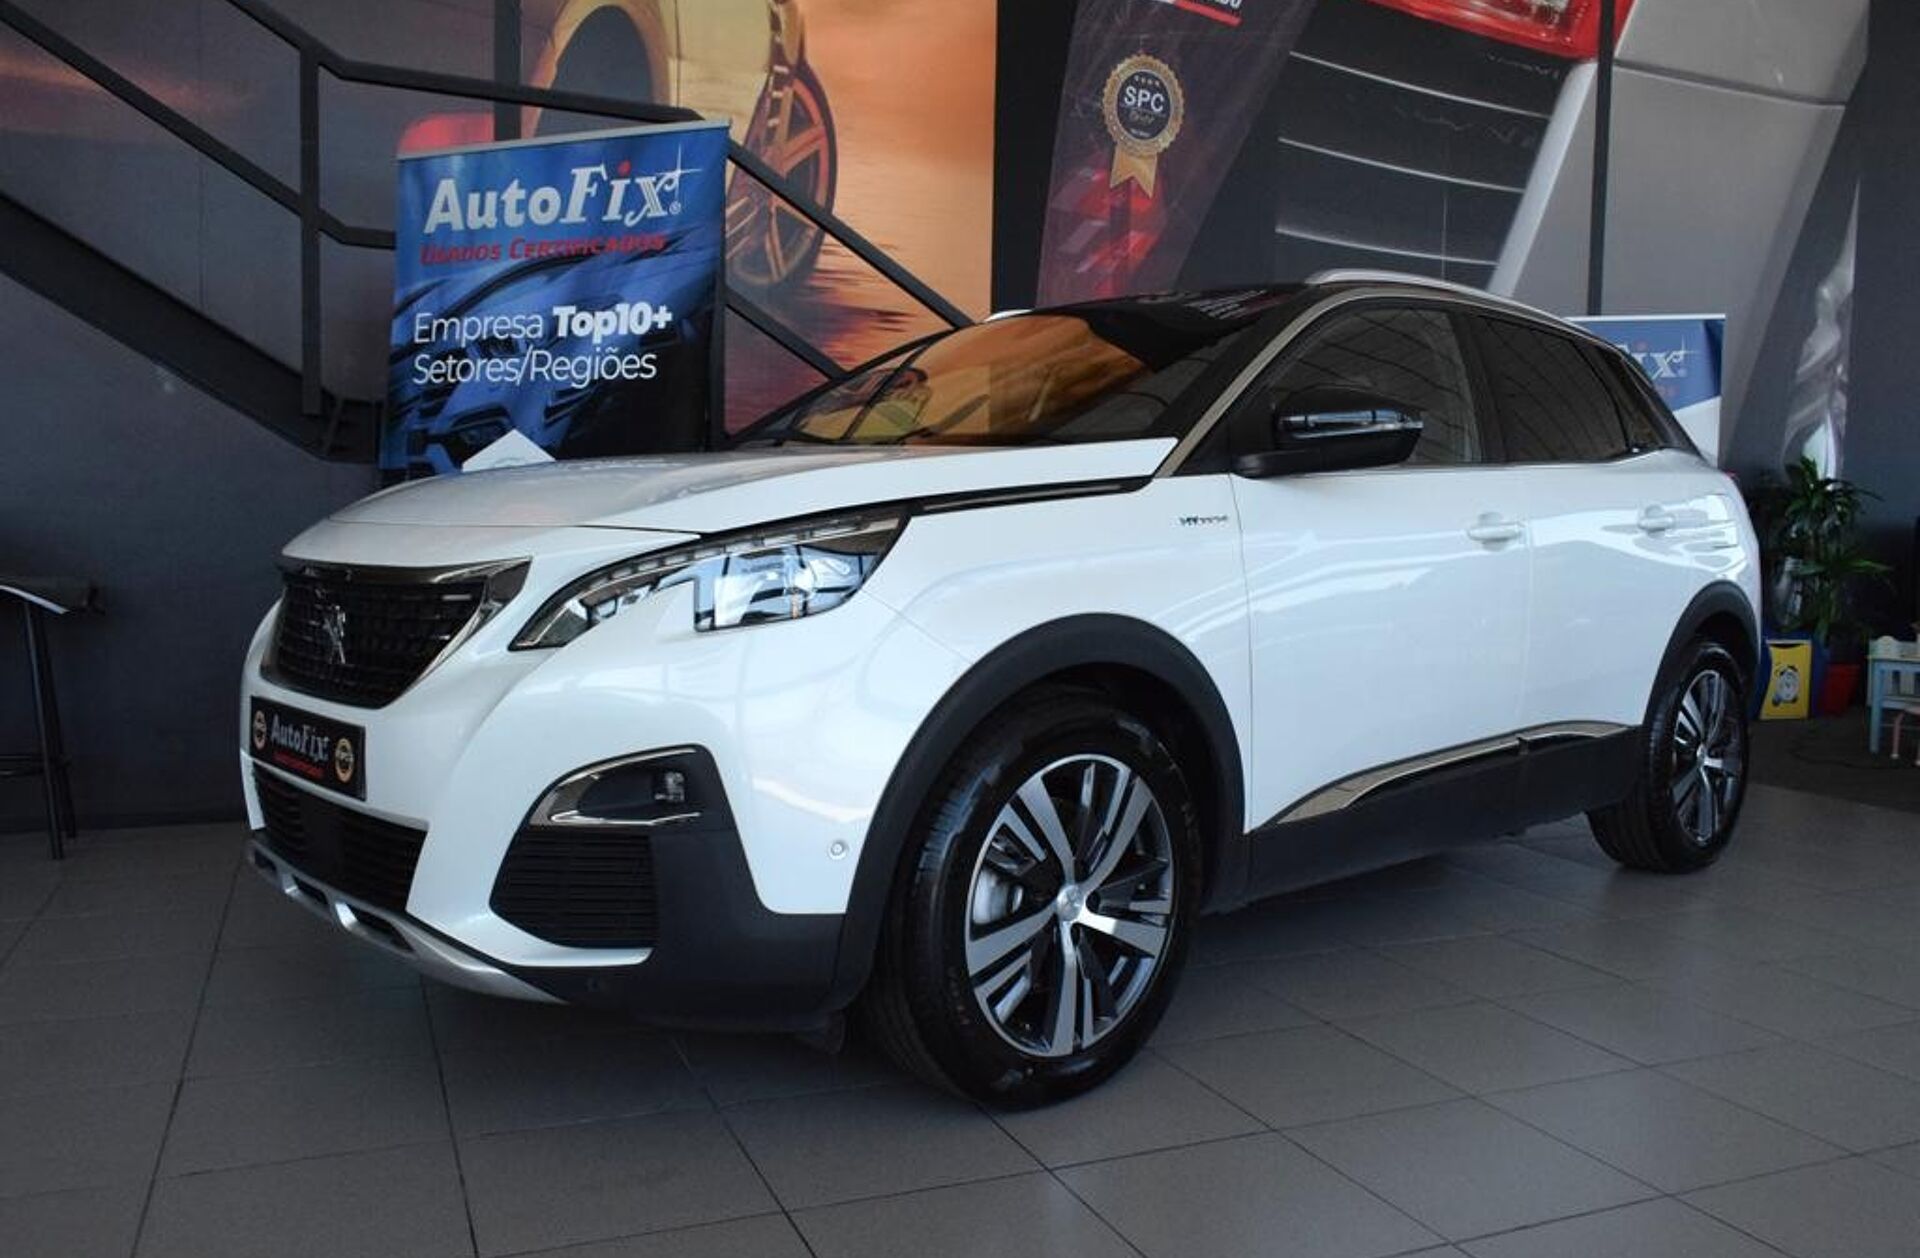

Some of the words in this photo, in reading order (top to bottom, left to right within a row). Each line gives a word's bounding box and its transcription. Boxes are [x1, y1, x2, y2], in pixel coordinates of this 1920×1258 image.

[1124, 85, 1164, 113] SPC
[414, 312, 543, 347] Empresa
[553, 302, 672, 343] Top10+
[413, 345, 657, 389] Setores/Regiões
